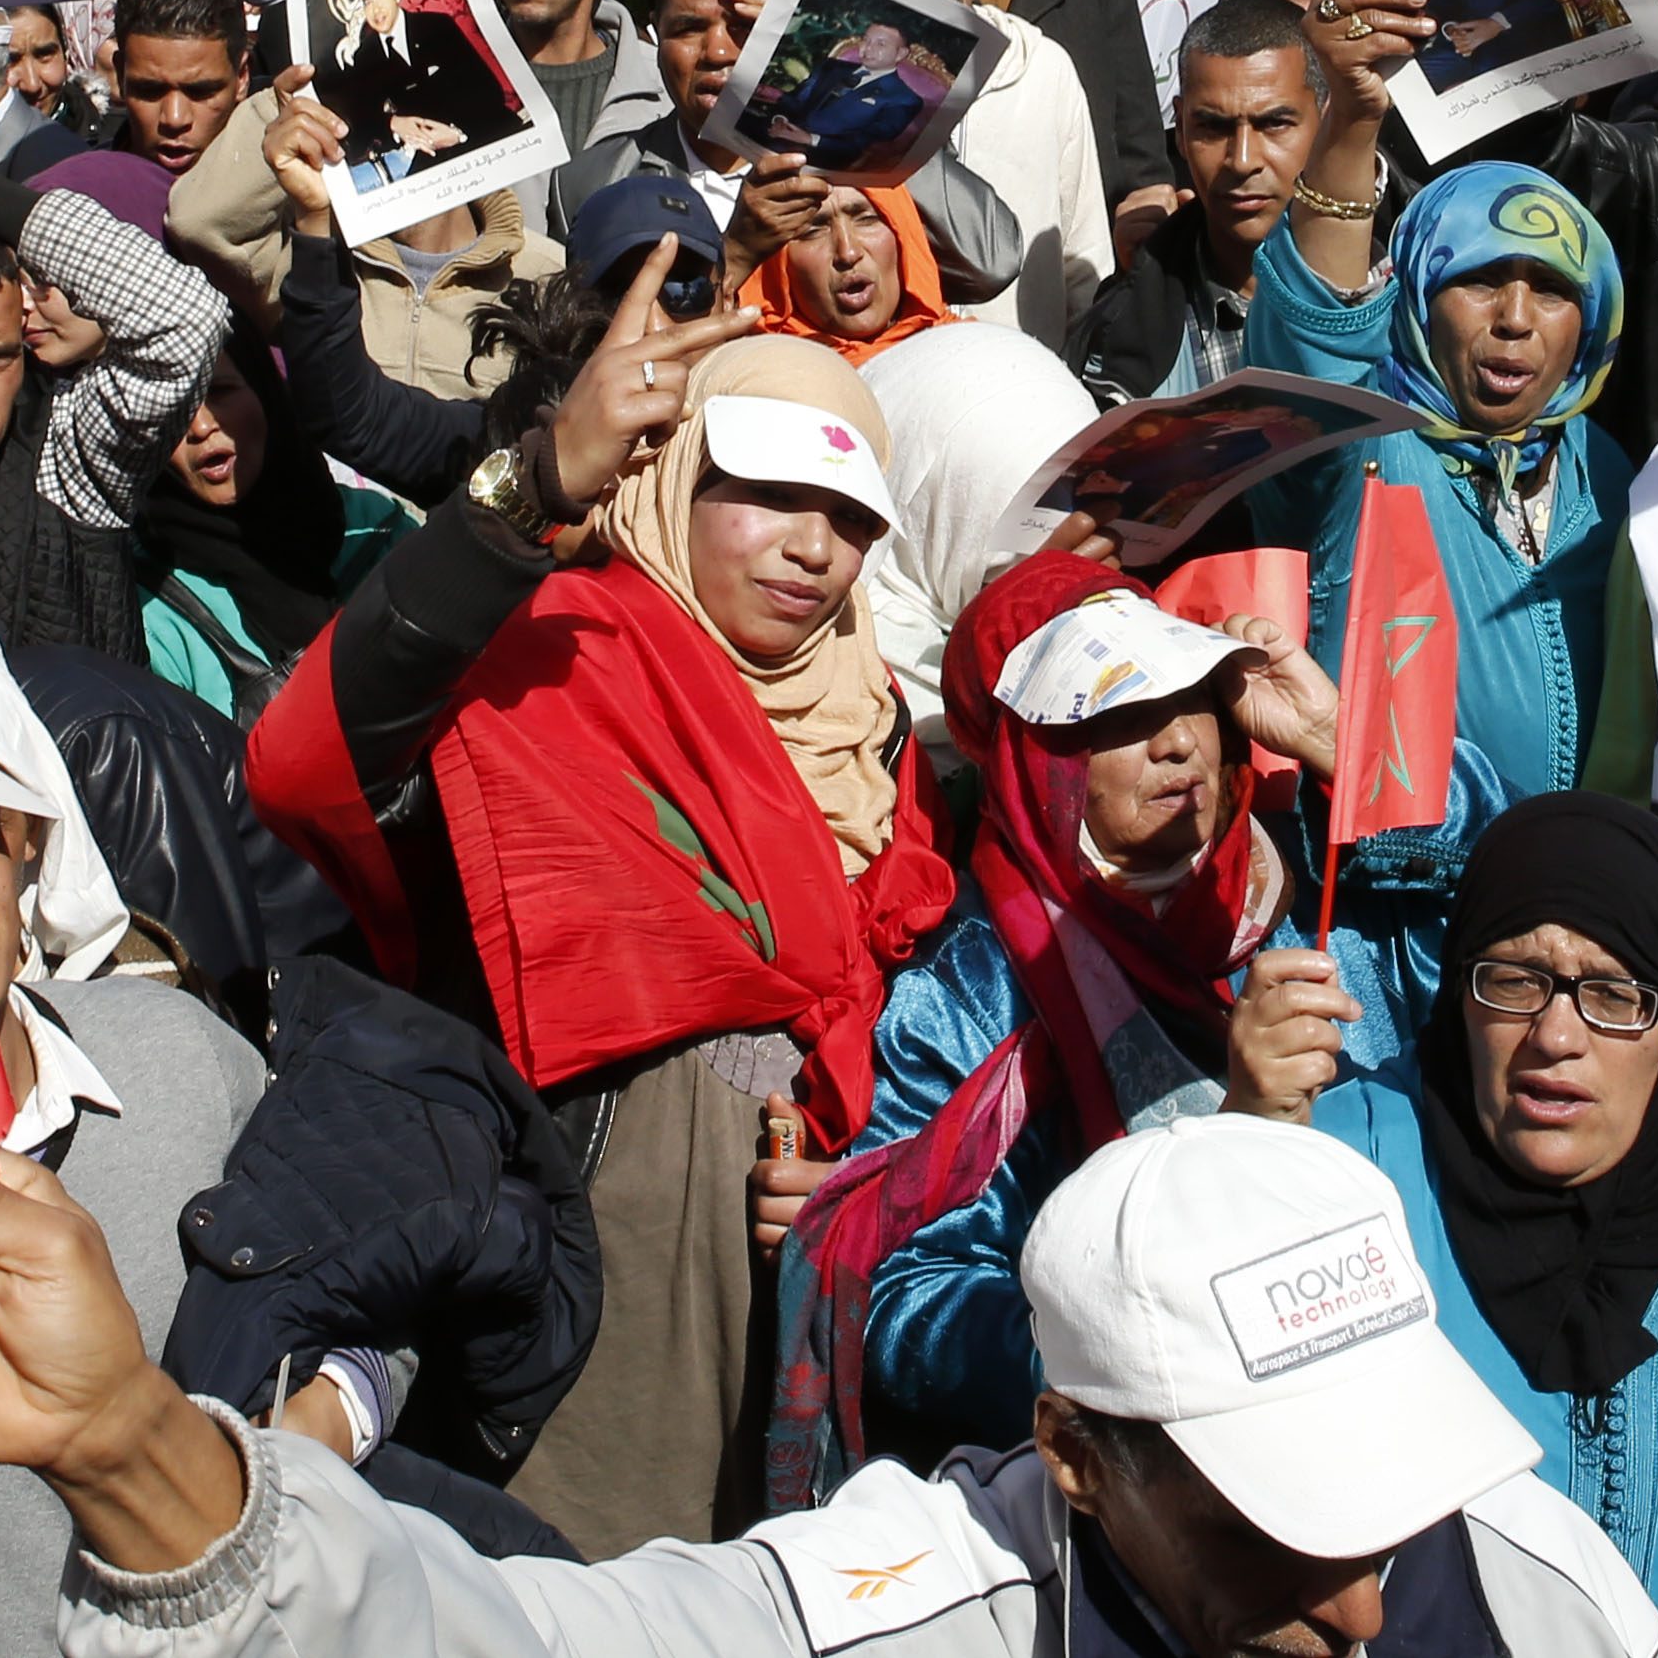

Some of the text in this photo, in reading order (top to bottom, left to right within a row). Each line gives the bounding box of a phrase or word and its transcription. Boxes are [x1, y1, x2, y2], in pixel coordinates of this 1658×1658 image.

[1264, 1235, 1387, 1314] novaé
[1277, 1275, 1398, 1333] technology
[1252, 1348, 1299, 1376] Aerospace
[1309, 1329, 1354, 1355] Transport
